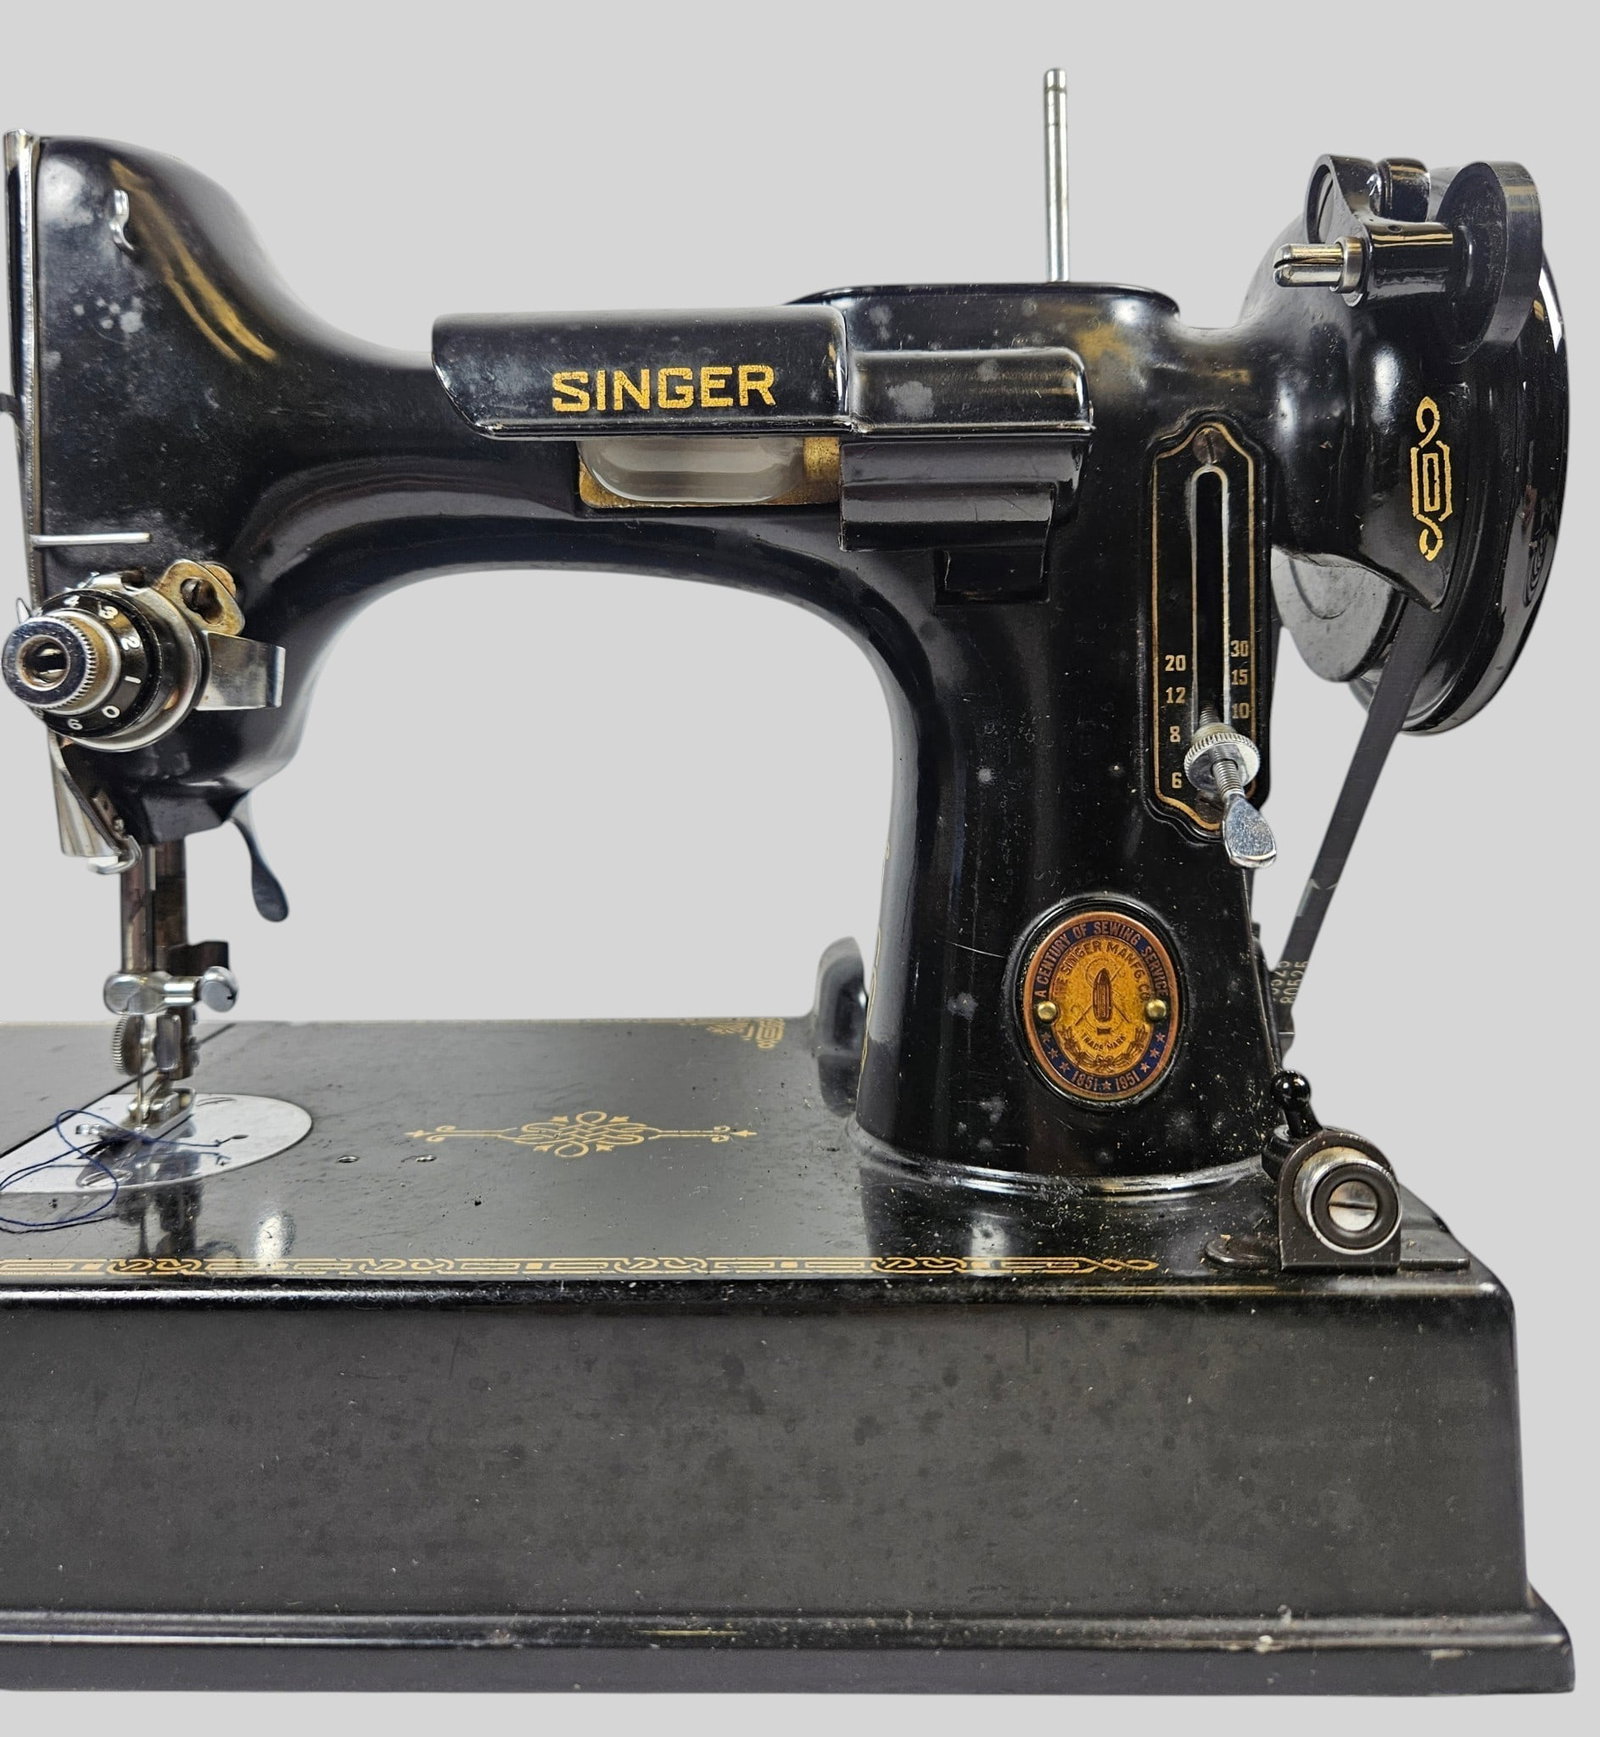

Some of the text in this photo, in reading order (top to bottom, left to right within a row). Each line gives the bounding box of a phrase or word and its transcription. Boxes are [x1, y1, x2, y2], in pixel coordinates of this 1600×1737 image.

[552, 364, 776, 412] SINGER
[64, 595, 81, 606] 4
[99, 605, 118, 620] 3
[121, 637, 140, 650] 2
[1230, 640, 1249, 657] 30
[1165, 655, 1186, 671] 20
[1231, 669, 1248, 686] 15
[1166, 687, 1186, 704] 12
[101, 705, 121, 718] 0
[1232, 703, 1249, 719] 10
[1169, 726, 1181, 743] 8
[1172, 772, 1182, 789] 6
[1034, 920, 1169, 998] A CENTURY OF SEWING SERVICE
[1061, 940, 1101, 976] SINGER
[1106, 1035, 1126, 1050] MARK
[1071, 1070, 1141, 1092] 1851 1951
